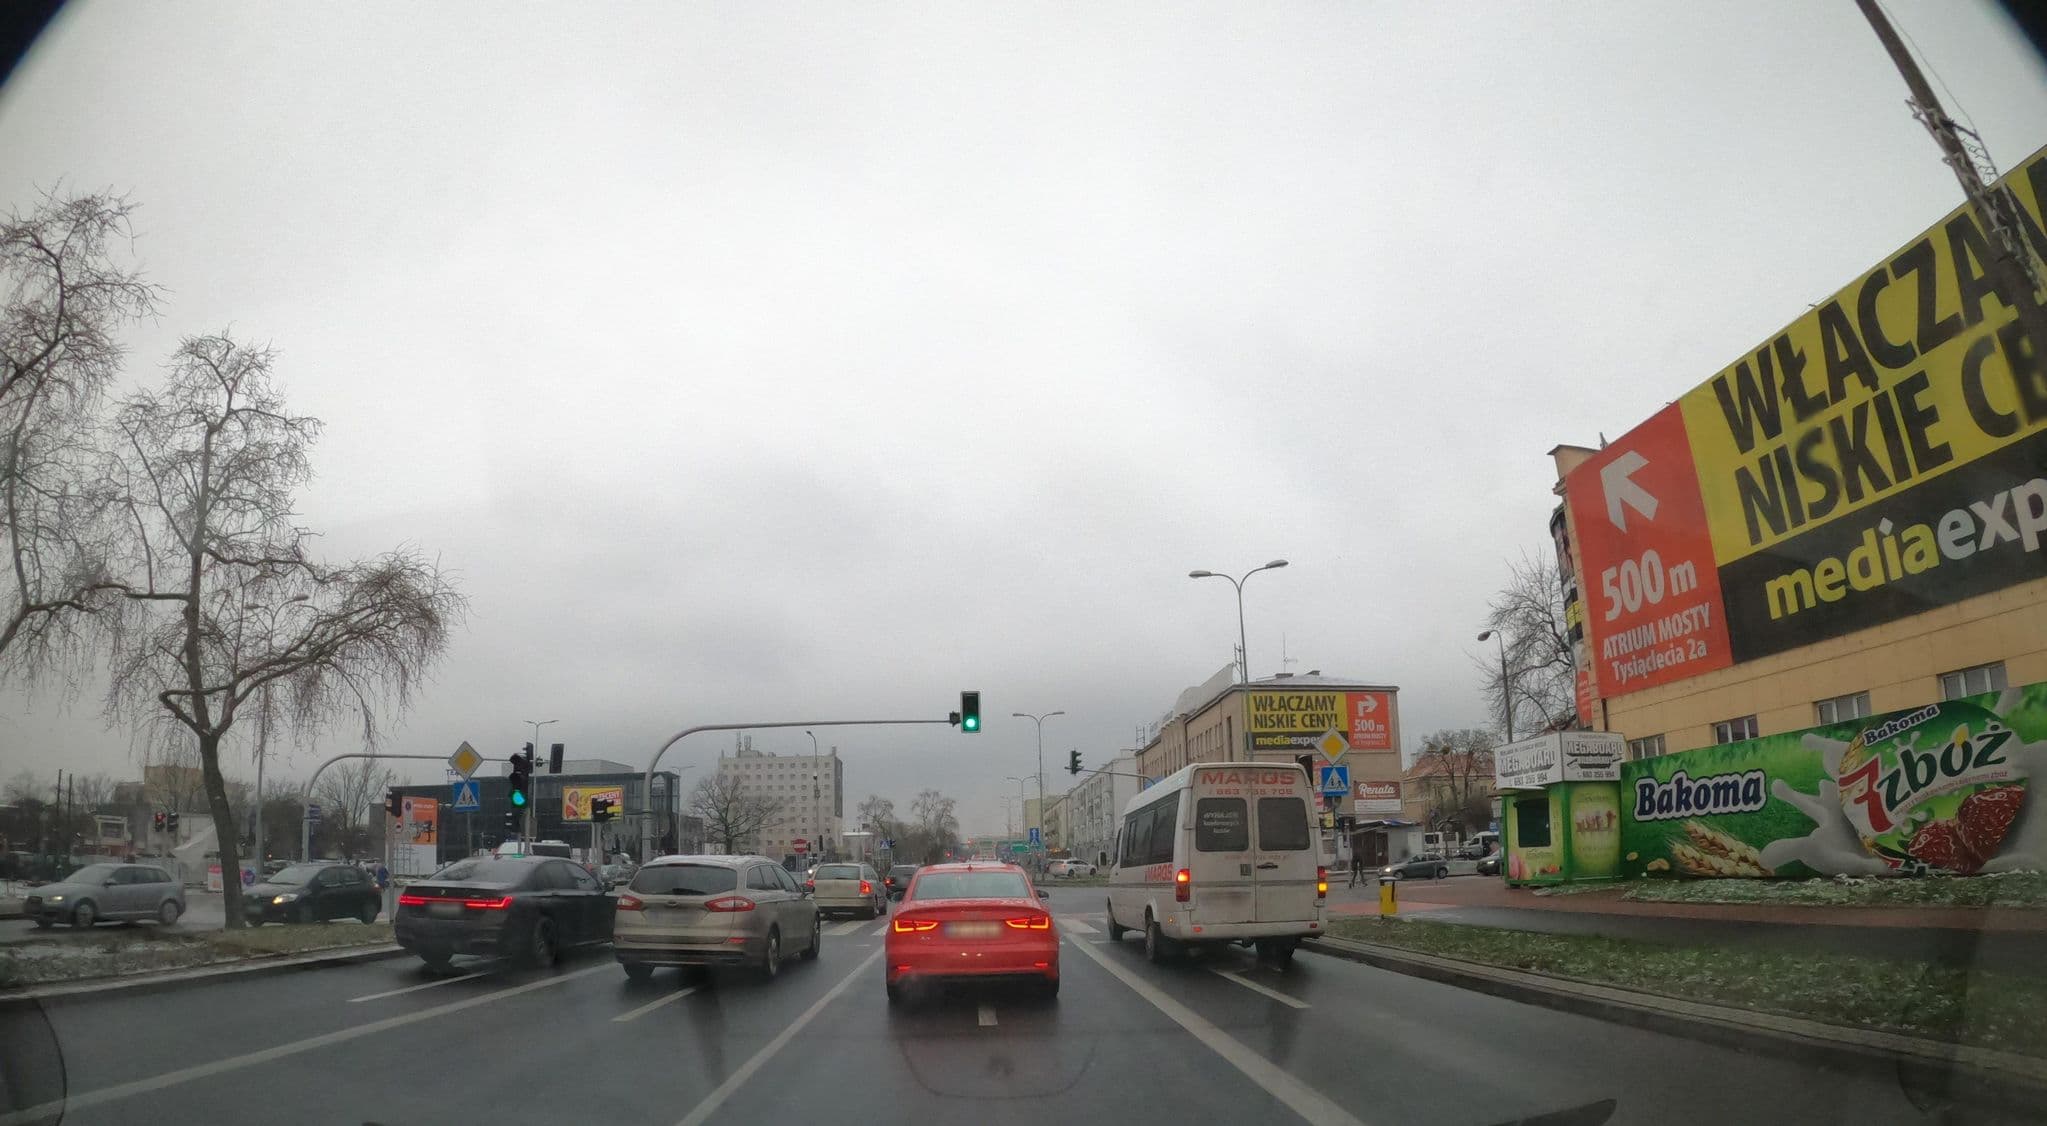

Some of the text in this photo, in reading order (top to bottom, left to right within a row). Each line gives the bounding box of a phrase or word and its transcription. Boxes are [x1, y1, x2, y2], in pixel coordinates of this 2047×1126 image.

[1735, 370, 1954, 546] NISKIE
[1765, 478, 2047, 620] mediaexp
[1602, 549, 1697, 622] 500 m
[1603, 602, 1710, 660] ATRIUM MOSTY
[1687, 638, 1707, 660] 2a
[1254, 714, 1338, 729] NISKIE CENY!
[1354, 719, 1385, 732] 500 m
[1864, 704, 1939, 745] Bakoma
[1200, 772, 1297, 785] MAROS
[1358, 783, 1397, 797] Renata
[1636, 774, 1763, 817] Bakoma
